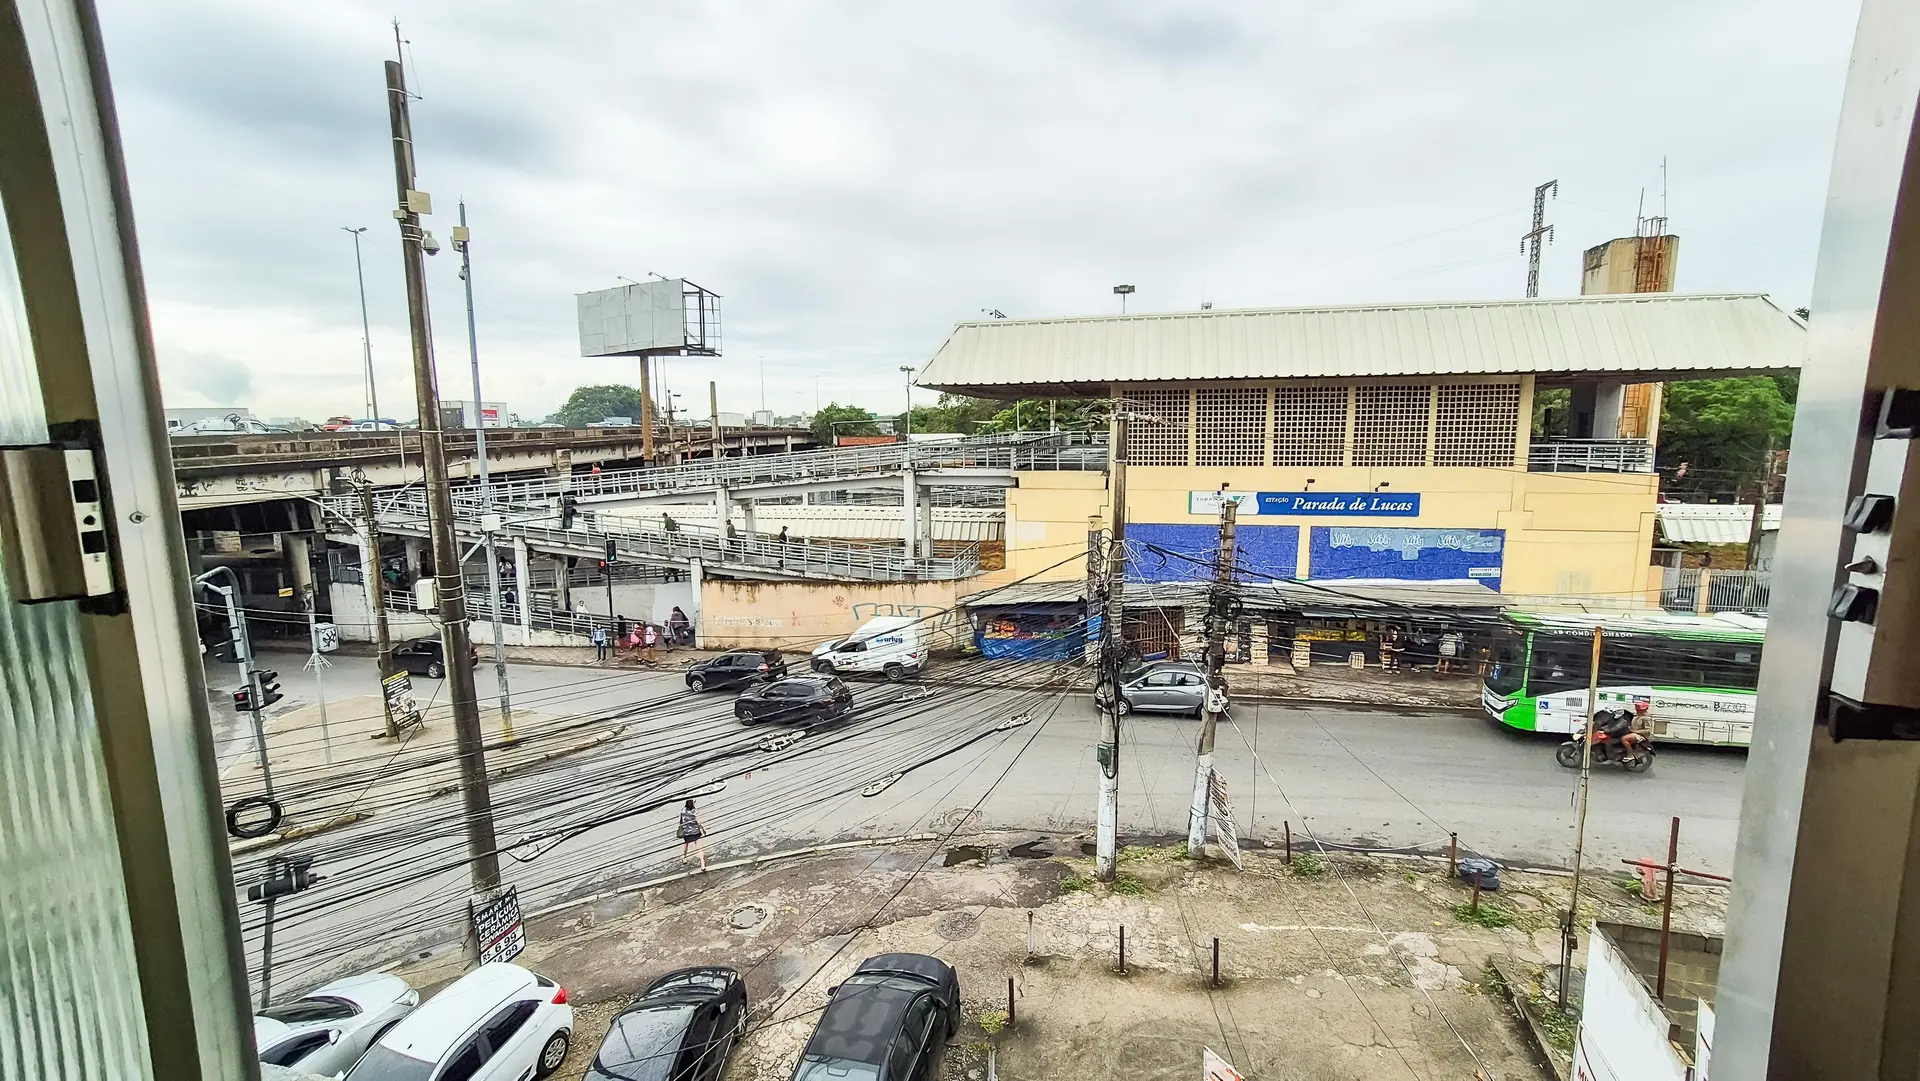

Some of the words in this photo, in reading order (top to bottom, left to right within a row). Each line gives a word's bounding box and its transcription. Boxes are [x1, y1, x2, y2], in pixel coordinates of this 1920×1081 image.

[1292, 497, 1345, 510] Parada
[1348, 497, 1367, 510] de
[1369, 498, 1413, 511] Lucas
[475, 901, 503, 924] SMART
